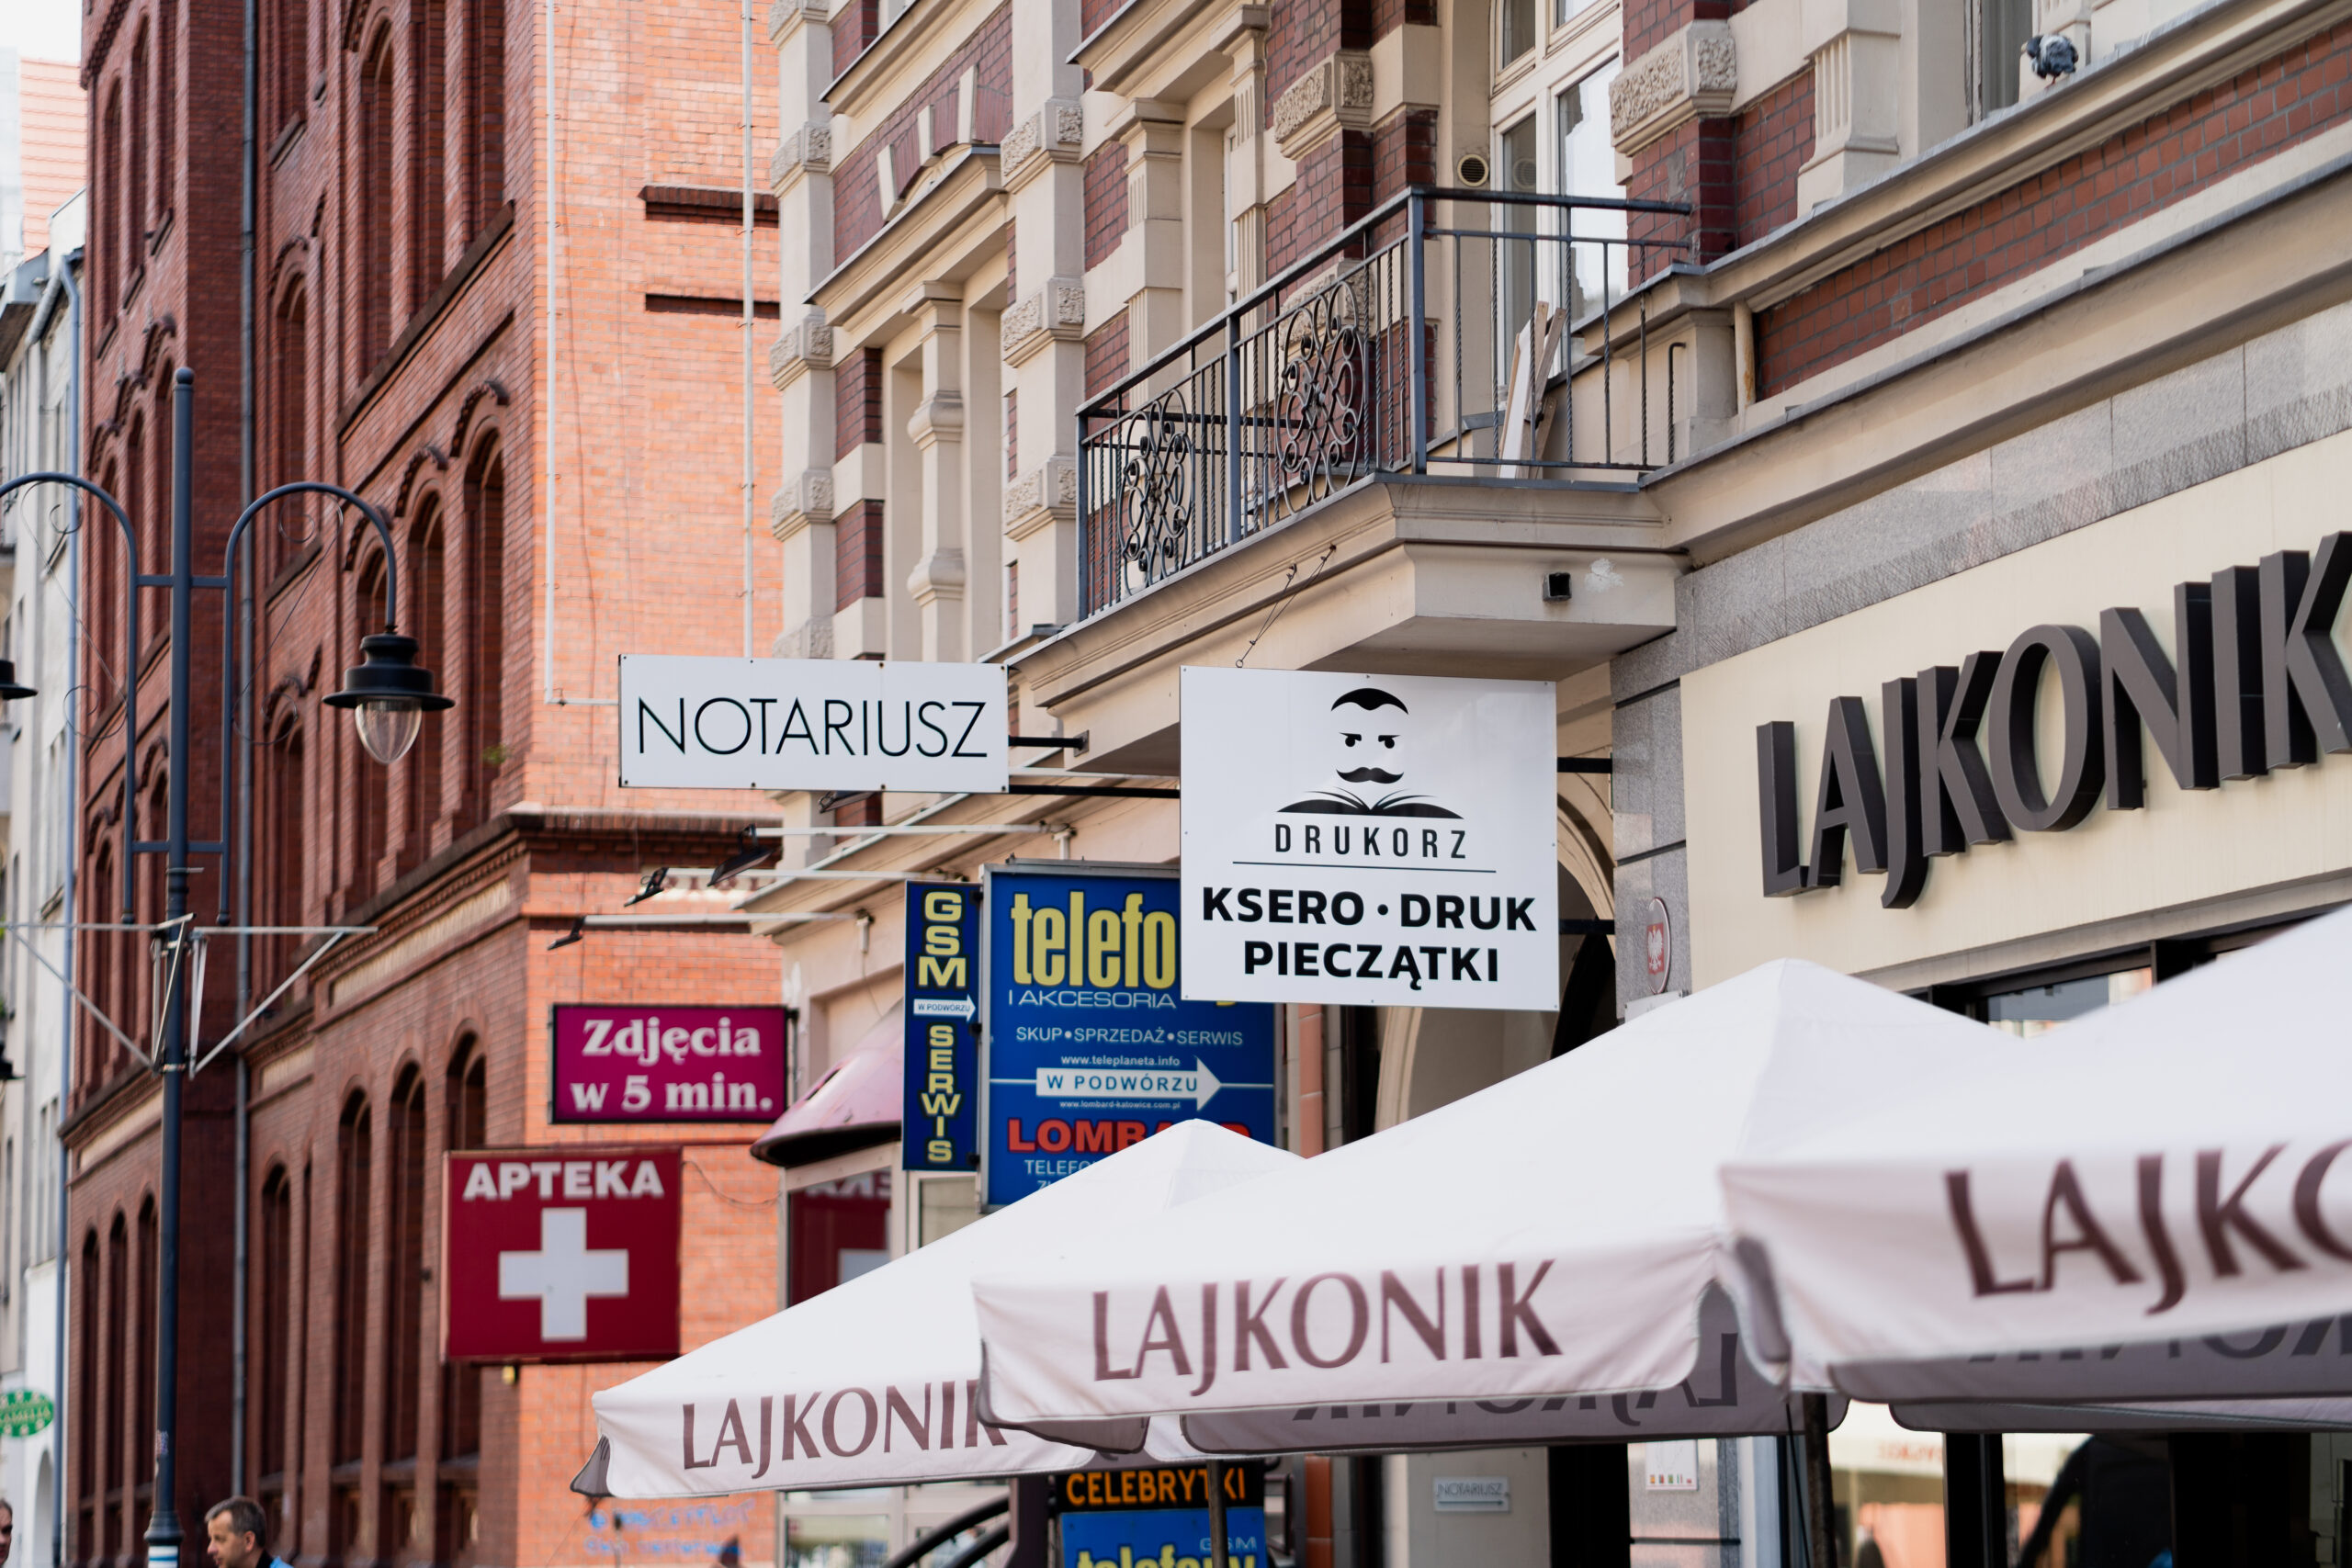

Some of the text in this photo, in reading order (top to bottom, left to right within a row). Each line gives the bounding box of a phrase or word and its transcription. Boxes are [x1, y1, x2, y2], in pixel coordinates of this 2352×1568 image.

[638, 695, 989, 758] NOTARIUSZ
[1756, 531, 2352, 909] LAJKONIK
[1274, 823, 1467, 860] DRUKORZ
[1202, 886, 1537, 931] KSERO DRUK
[917, 891, 967, 988] GSM
[1010, 889, 1177, 990] telefo
[1243, 940, 1498, 991] PIECZĄTKI
[1008, 989, 1177, 1010] I AKCESORIA
[581, 1015, 762, 1066] Zdjęcia
[1060, 1055, 1181, 1066] www.teleplaneta.info
[570, 1072, 774, 1112] w 5 min.
[921, 1024, 962, 1164] SERWIS
[1046, 1073, 1198, 1092] W PODWÓRZU
[1007, 1118, 1252, 1154] LOMB
[462, 1160, 665, 1201] APTEKA
[1092, 1258, 1564, 1398] LAJKONIK
